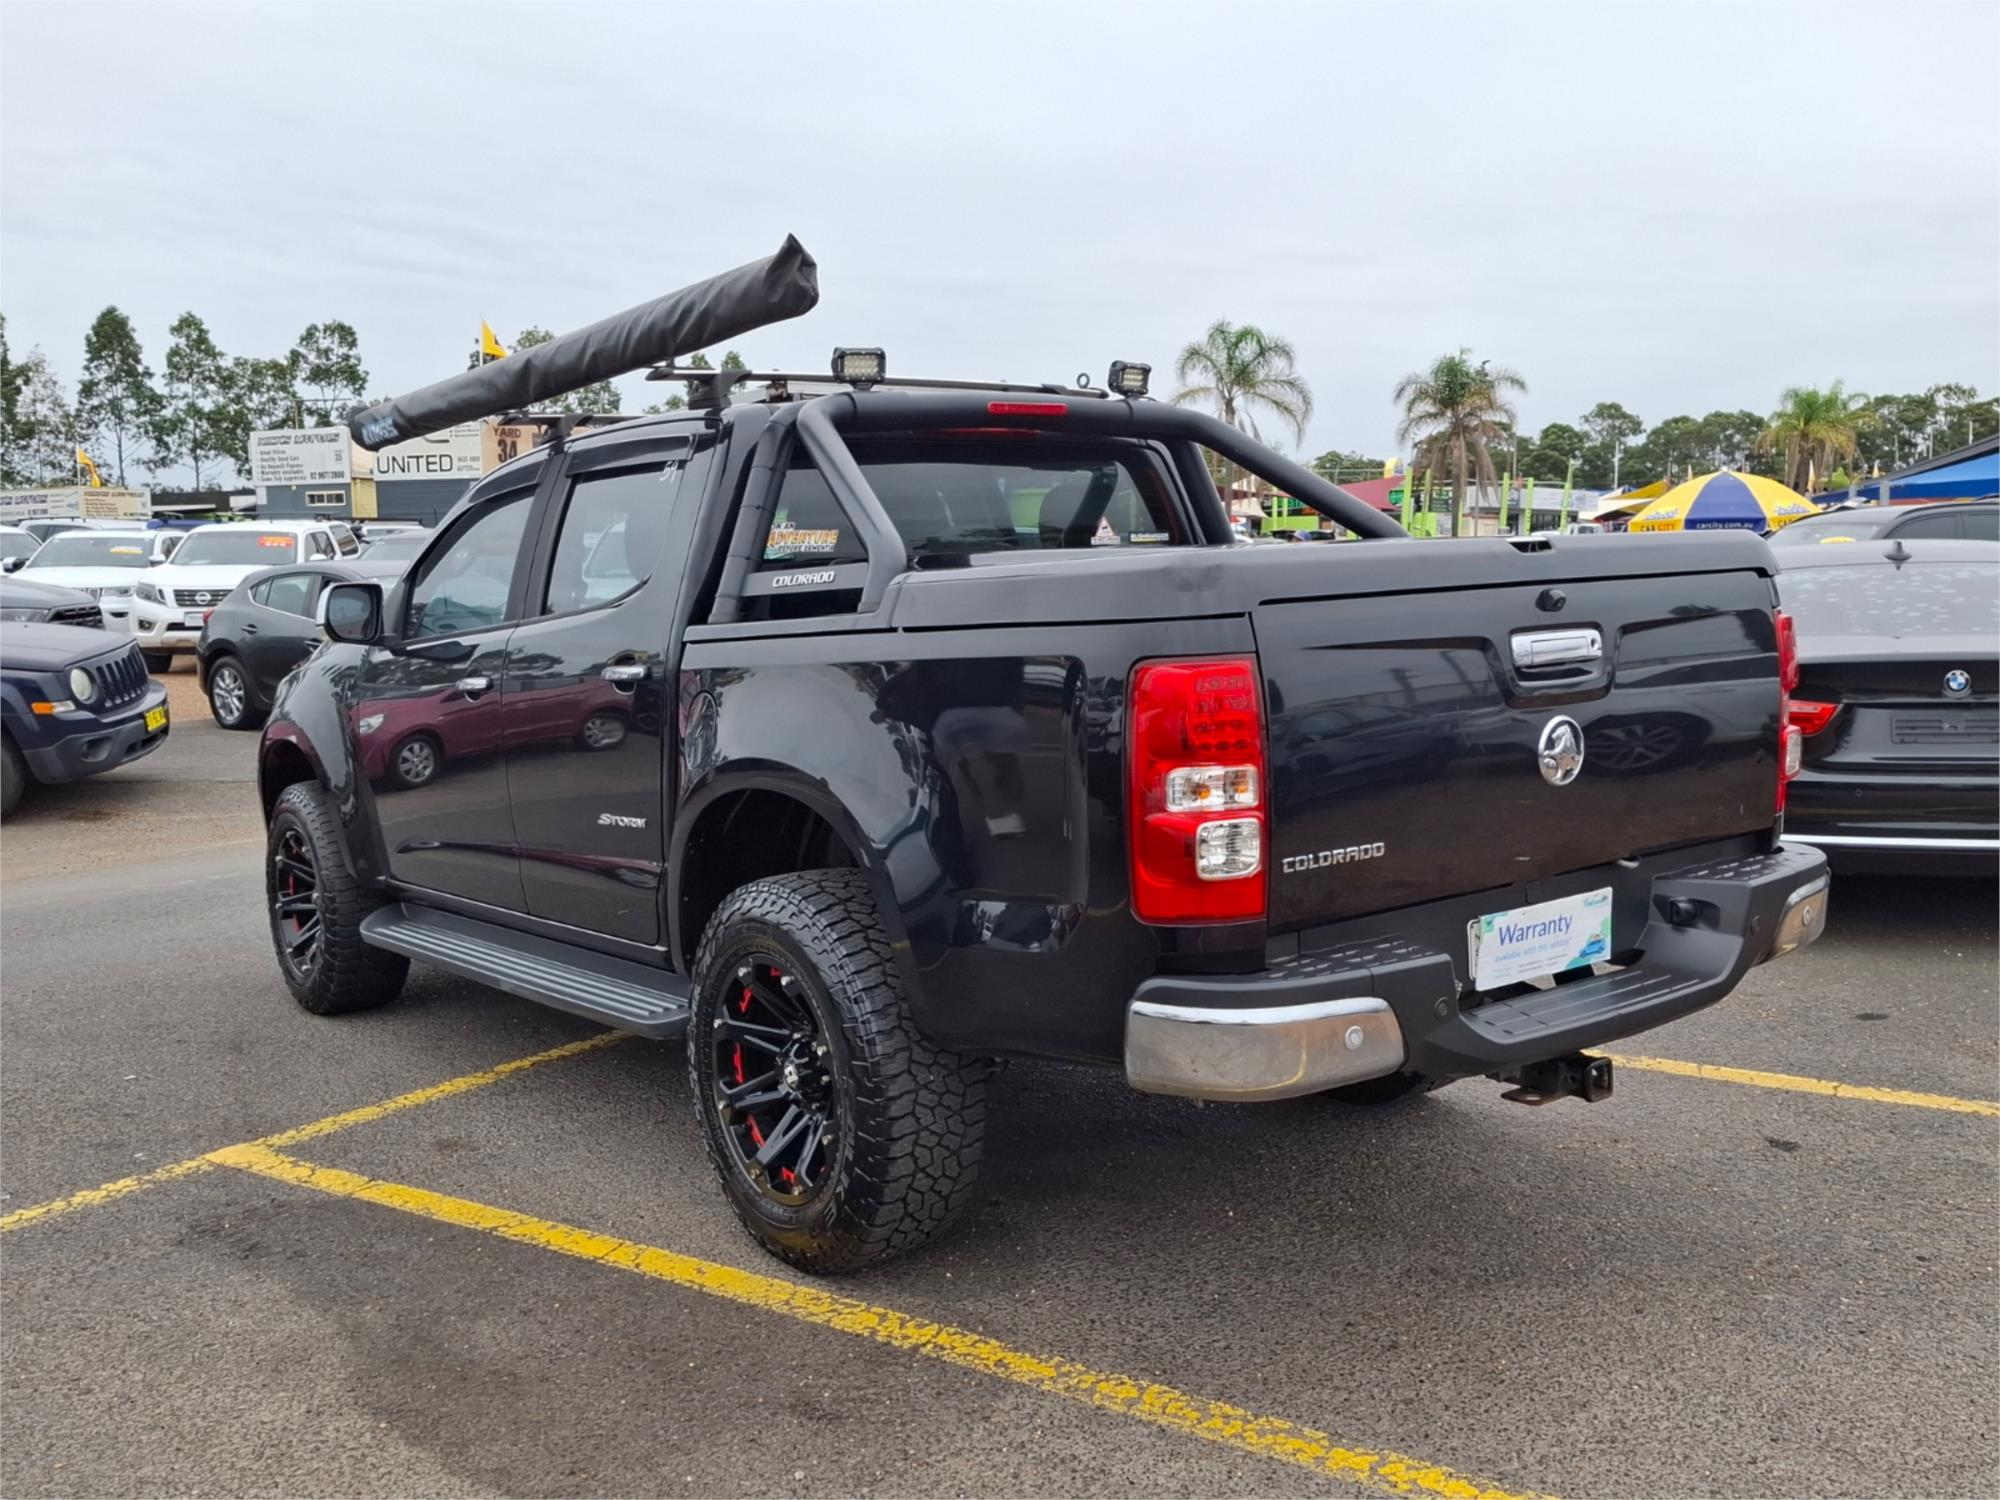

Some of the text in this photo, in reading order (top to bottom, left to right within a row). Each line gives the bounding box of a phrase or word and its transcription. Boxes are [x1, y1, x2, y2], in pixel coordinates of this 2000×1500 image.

[492, 426, 522, 439] YARD
[1696, 520, 1754, 530] carcity.com.au
[772, 570, 836, 588] COLORADO
[1281, 842, 1386, 874] COLORADO
[1498, 914, 1573, 946] Warranty
